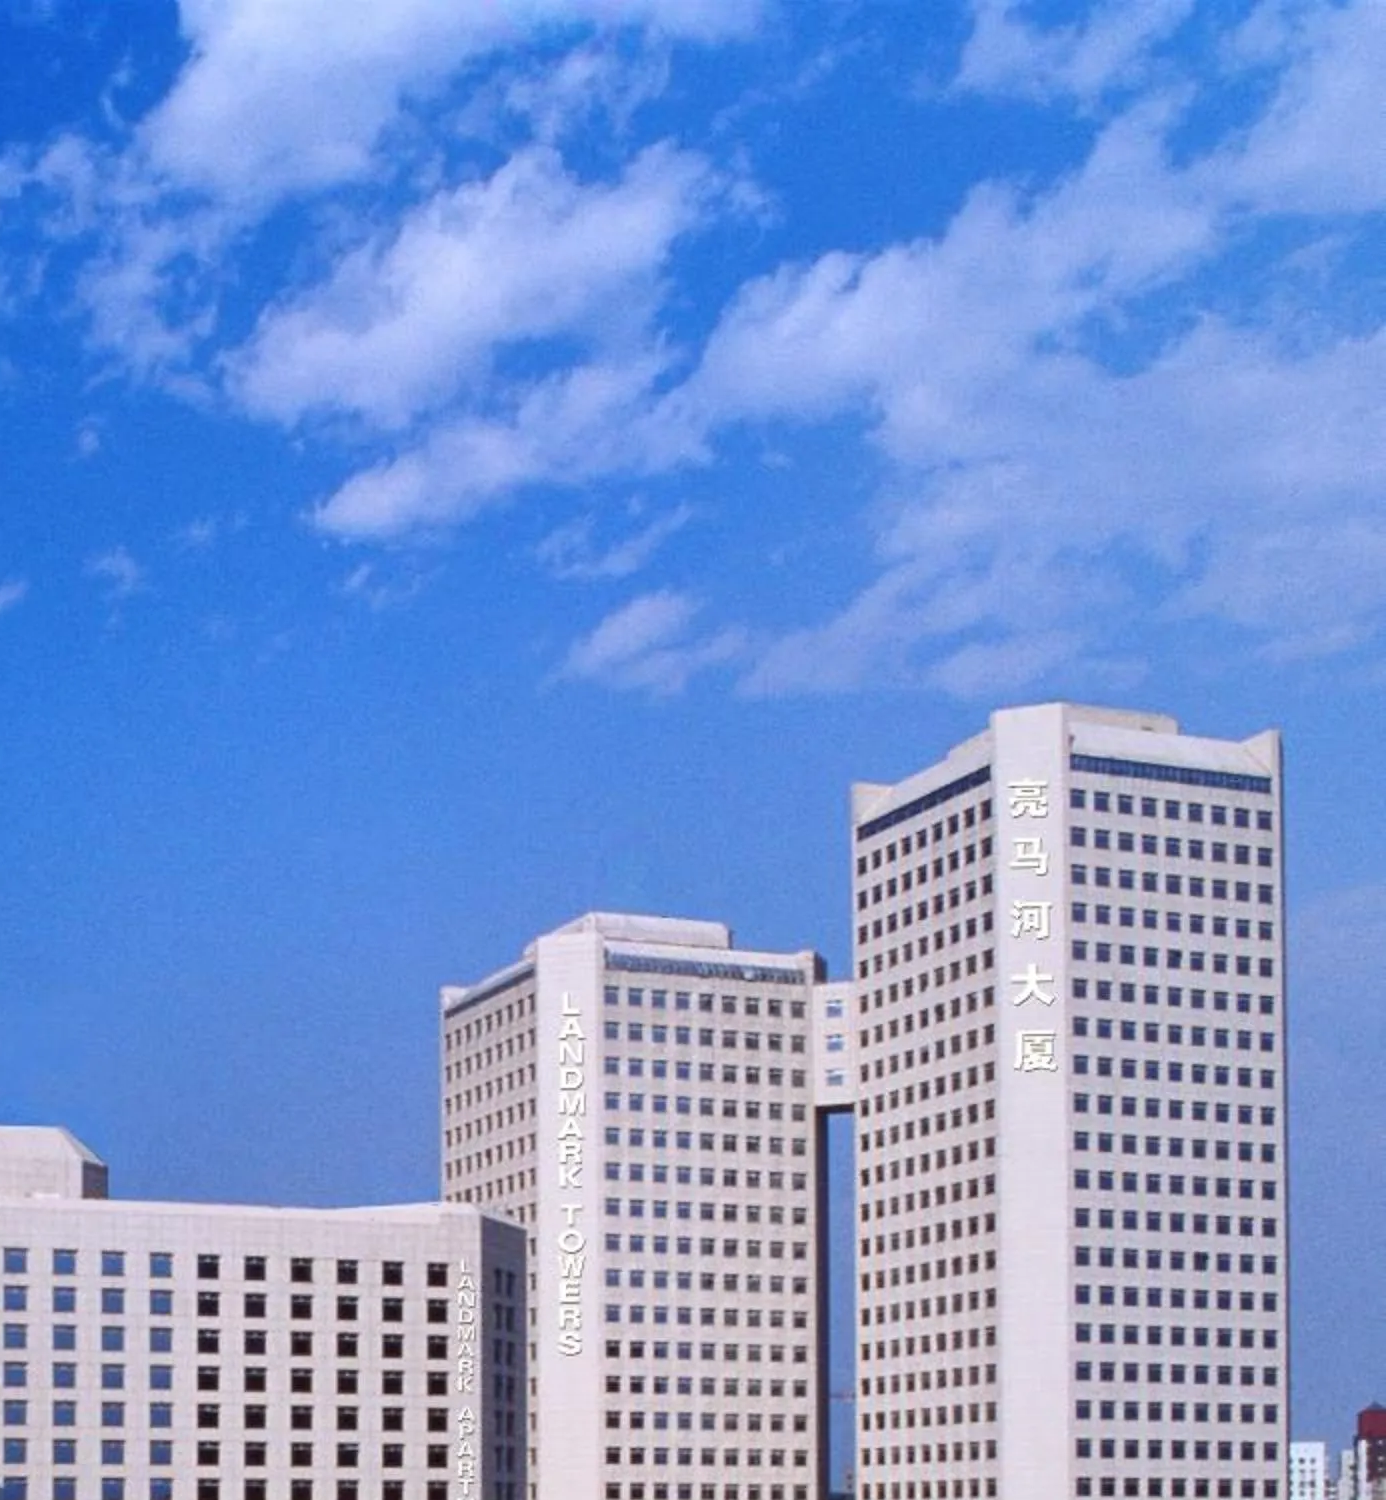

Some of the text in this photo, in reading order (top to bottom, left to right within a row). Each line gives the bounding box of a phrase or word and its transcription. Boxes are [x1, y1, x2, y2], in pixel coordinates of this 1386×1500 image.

[1008, 778, 1058, 1073] 亮马河大厦
[558, 991, 586, 1357] LANDMARK TOWERS
[457, 1259, 476, 1393] LANDMARK
